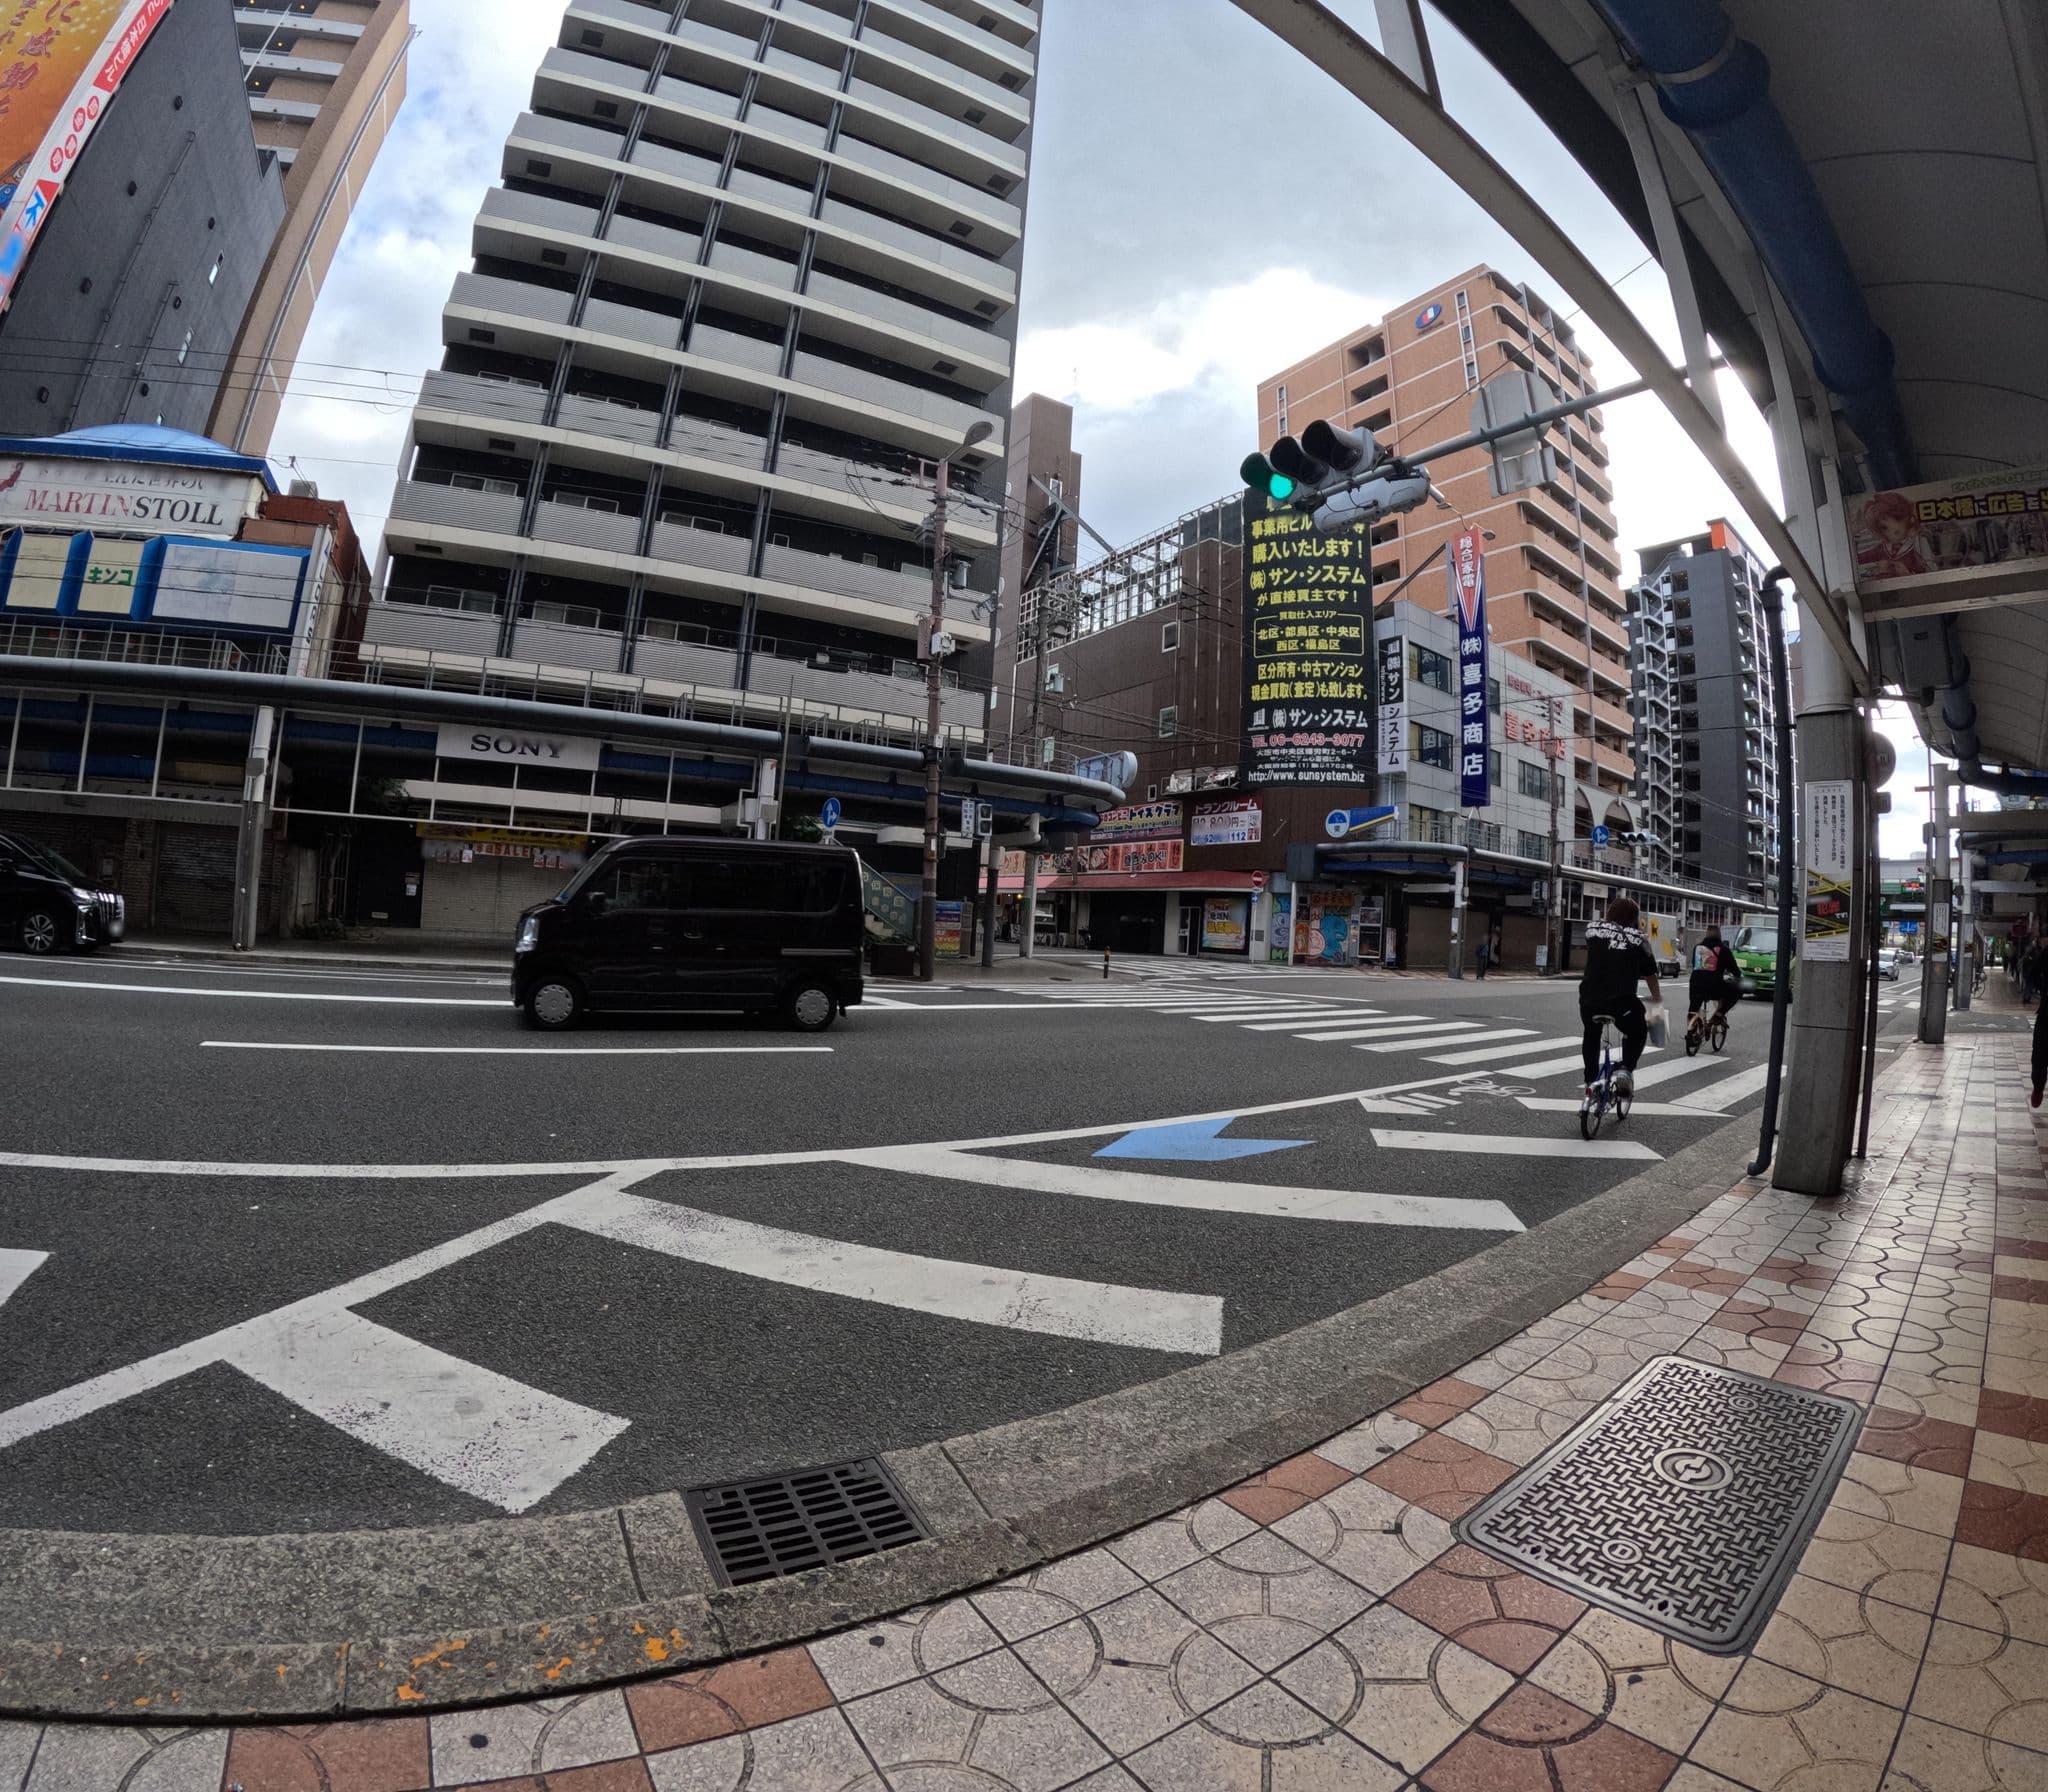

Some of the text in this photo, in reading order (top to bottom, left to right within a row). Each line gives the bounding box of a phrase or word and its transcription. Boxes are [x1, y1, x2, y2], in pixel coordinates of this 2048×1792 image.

[87, 565, 134, 587] キンコ
[470, 734, 567, 759] SONY
[1195, 798, 1258, 815] トランクルーム
